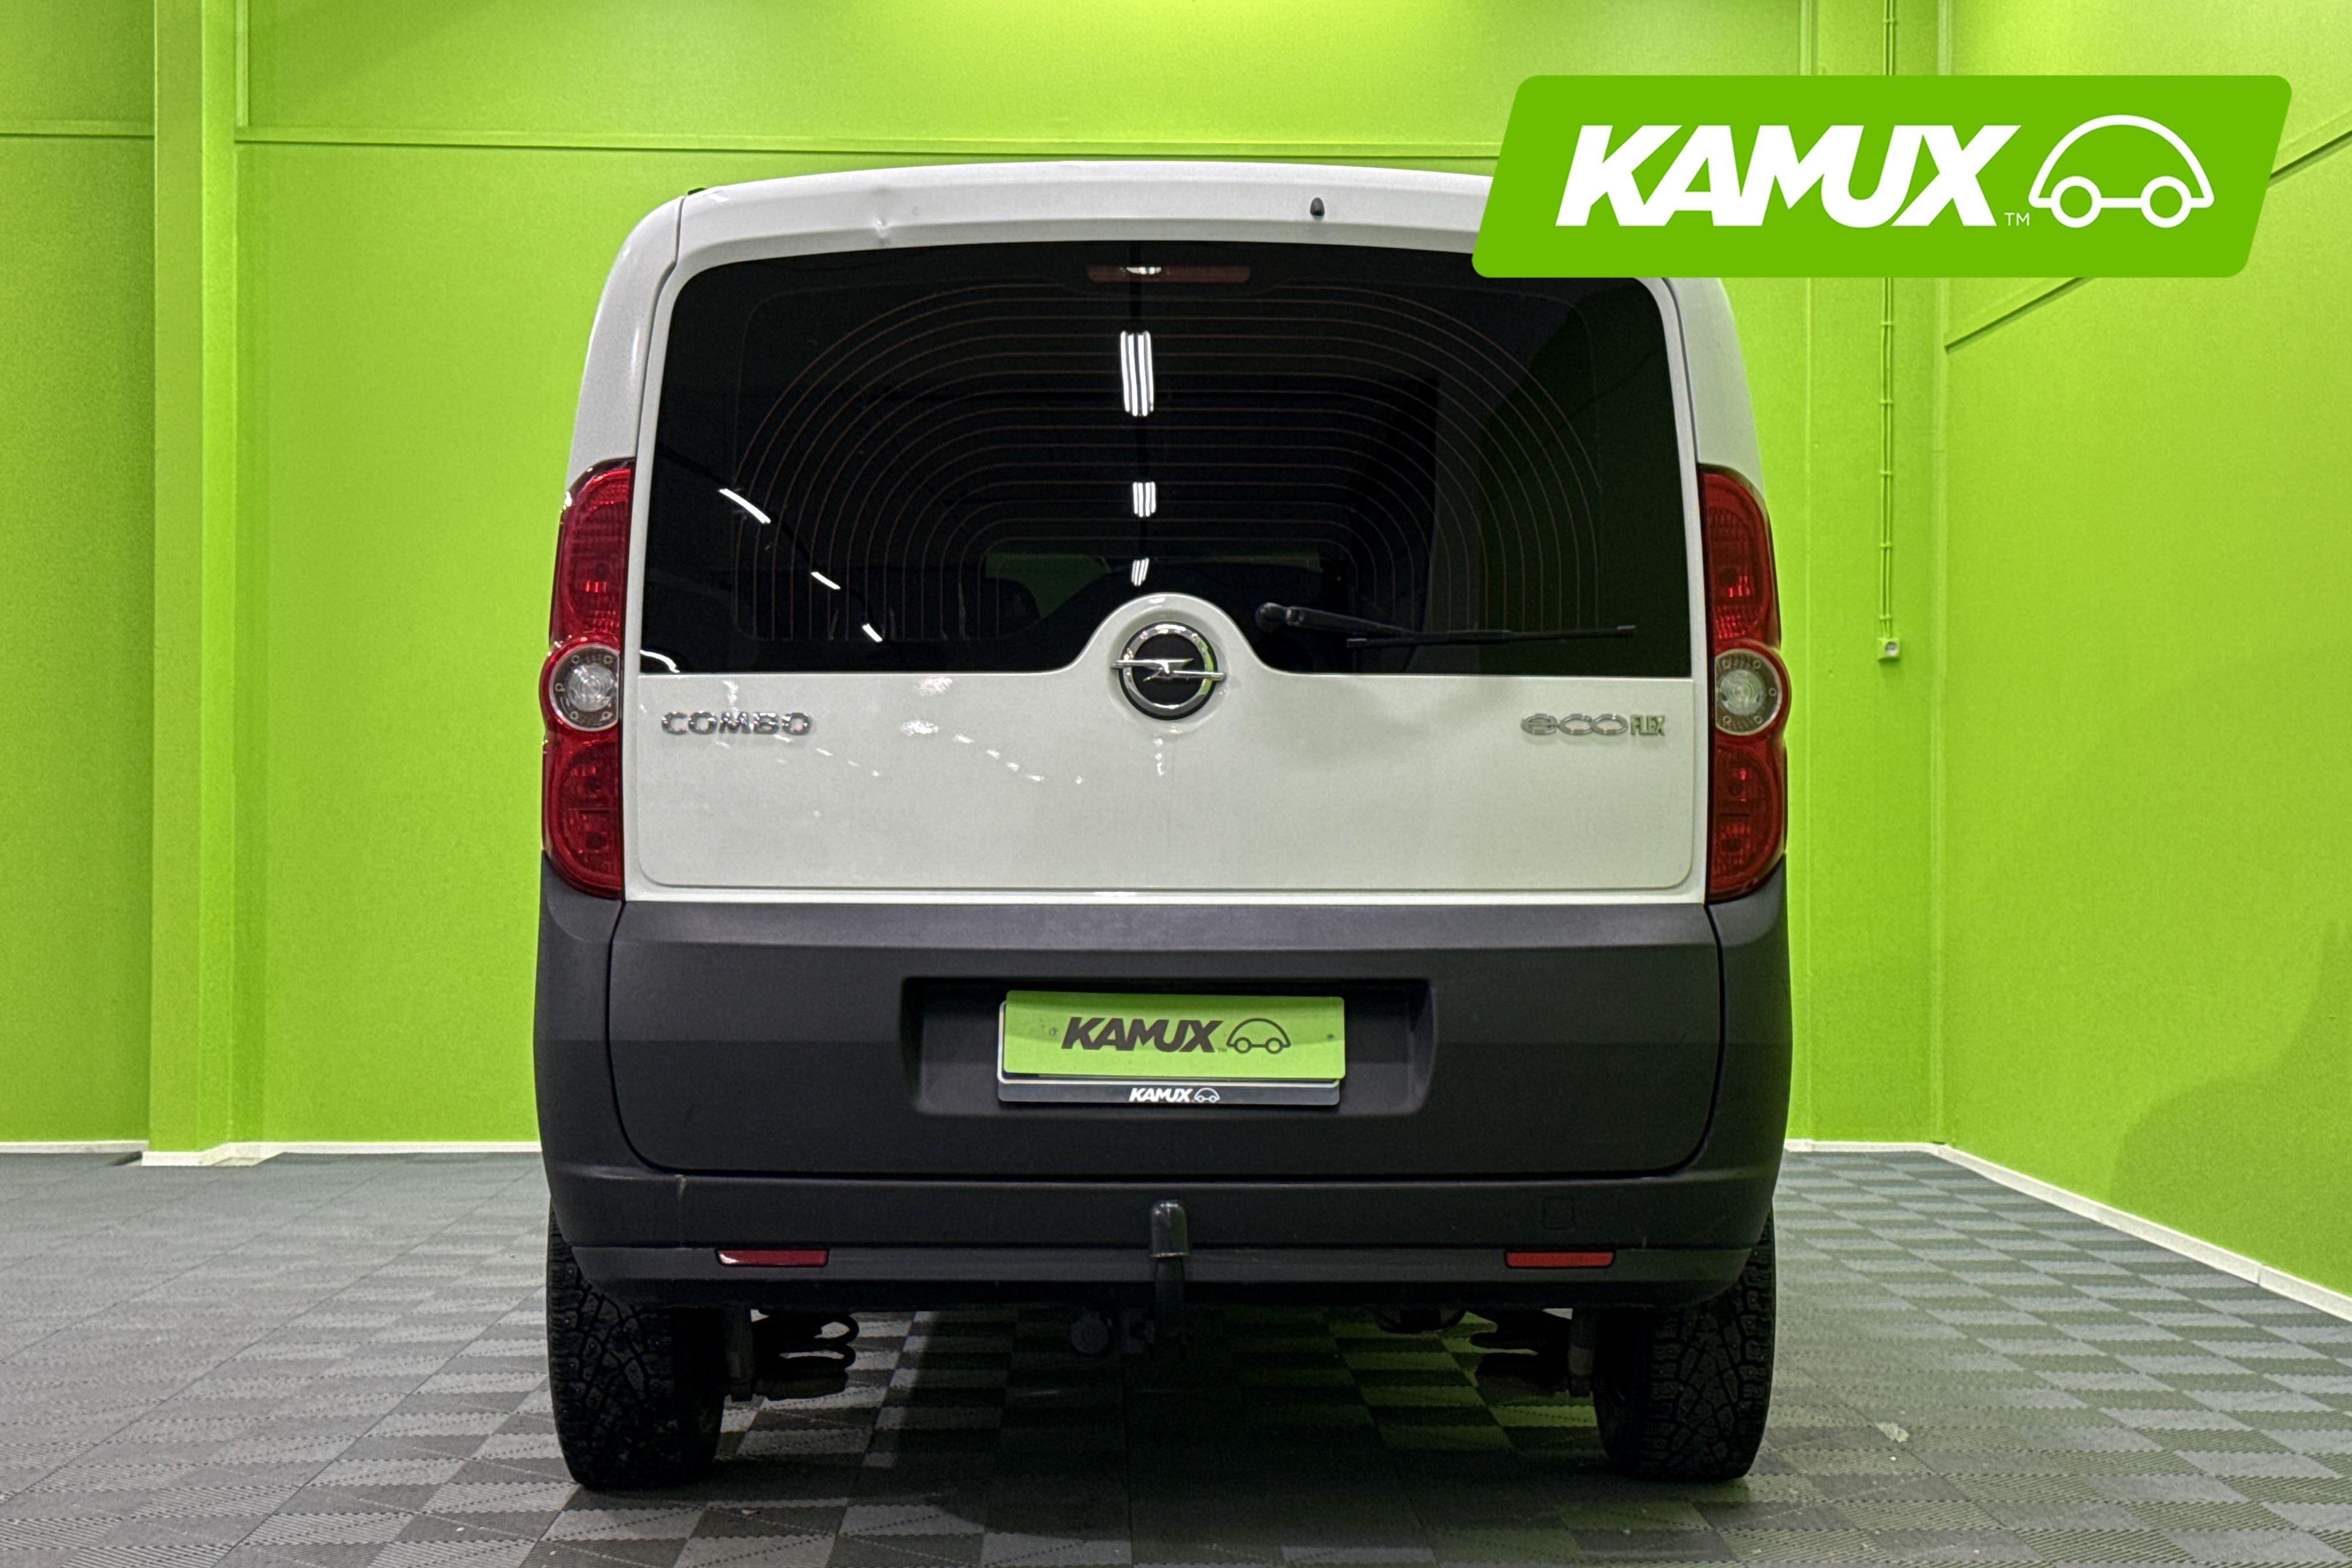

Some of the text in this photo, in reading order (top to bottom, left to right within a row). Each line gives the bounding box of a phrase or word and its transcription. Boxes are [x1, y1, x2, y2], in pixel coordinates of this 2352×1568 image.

[662, 711, 812, 735] COMBO
[1061, 1016, 1224, 1054] KAMUX
[1129, 1087, 1193, 1103] KAMUX
